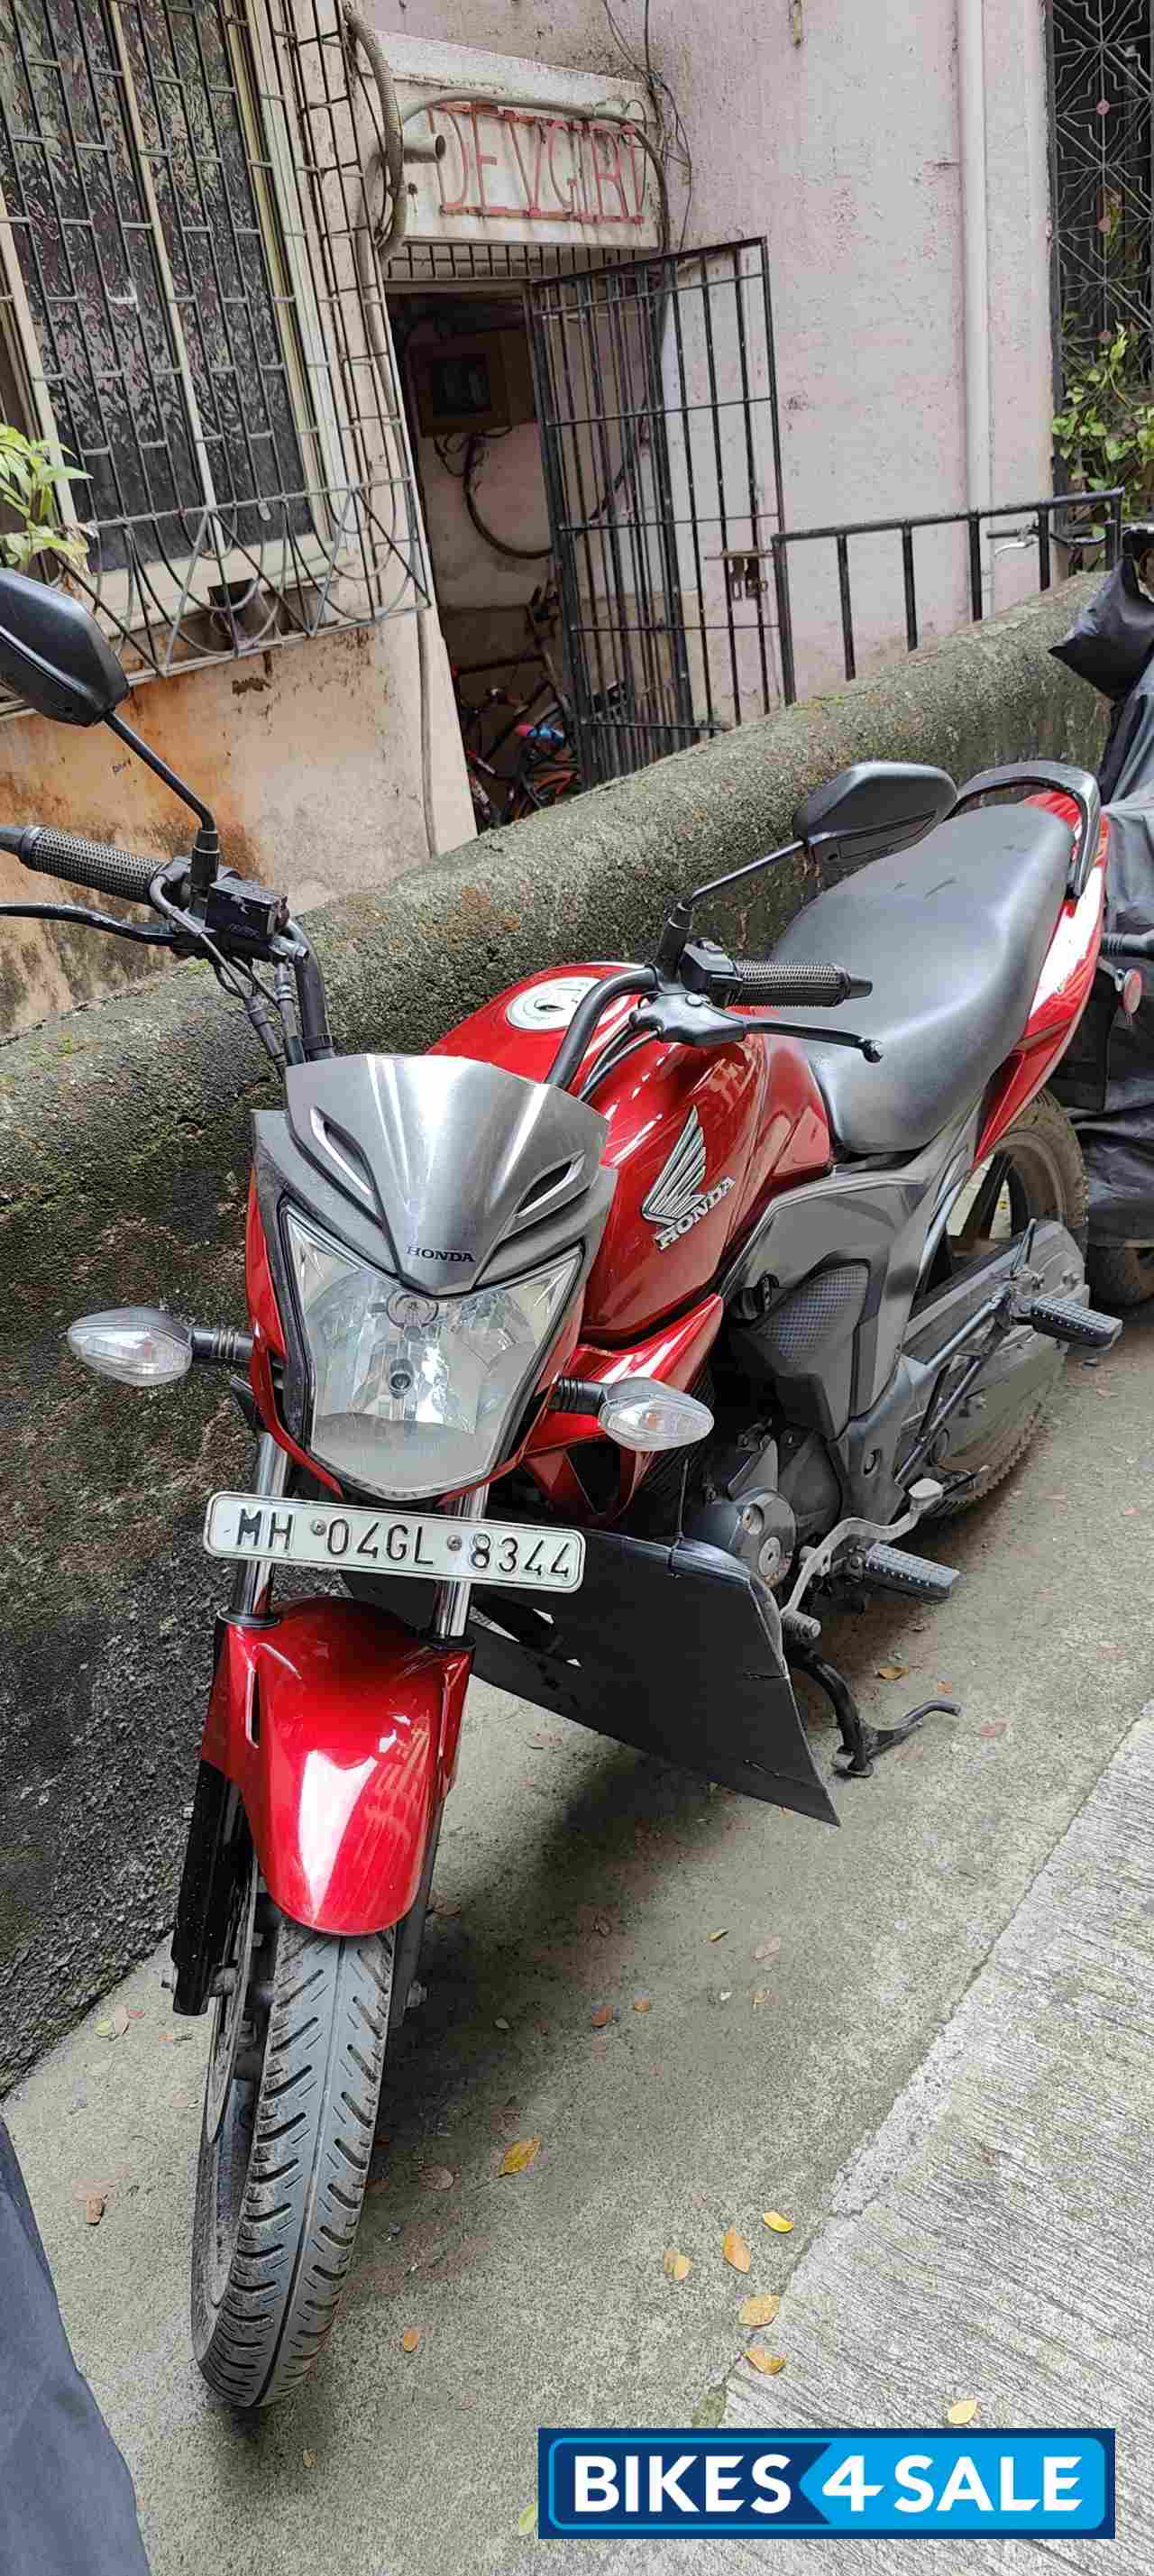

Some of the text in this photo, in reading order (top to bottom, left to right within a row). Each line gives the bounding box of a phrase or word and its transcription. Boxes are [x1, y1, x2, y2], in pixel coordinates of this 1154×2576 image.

[654, 1176, 736, 1250] HONDA
[407, 1246, 476, 1262] HONDA
[235, 1508, 570, 1579] MH 04GL 8344
